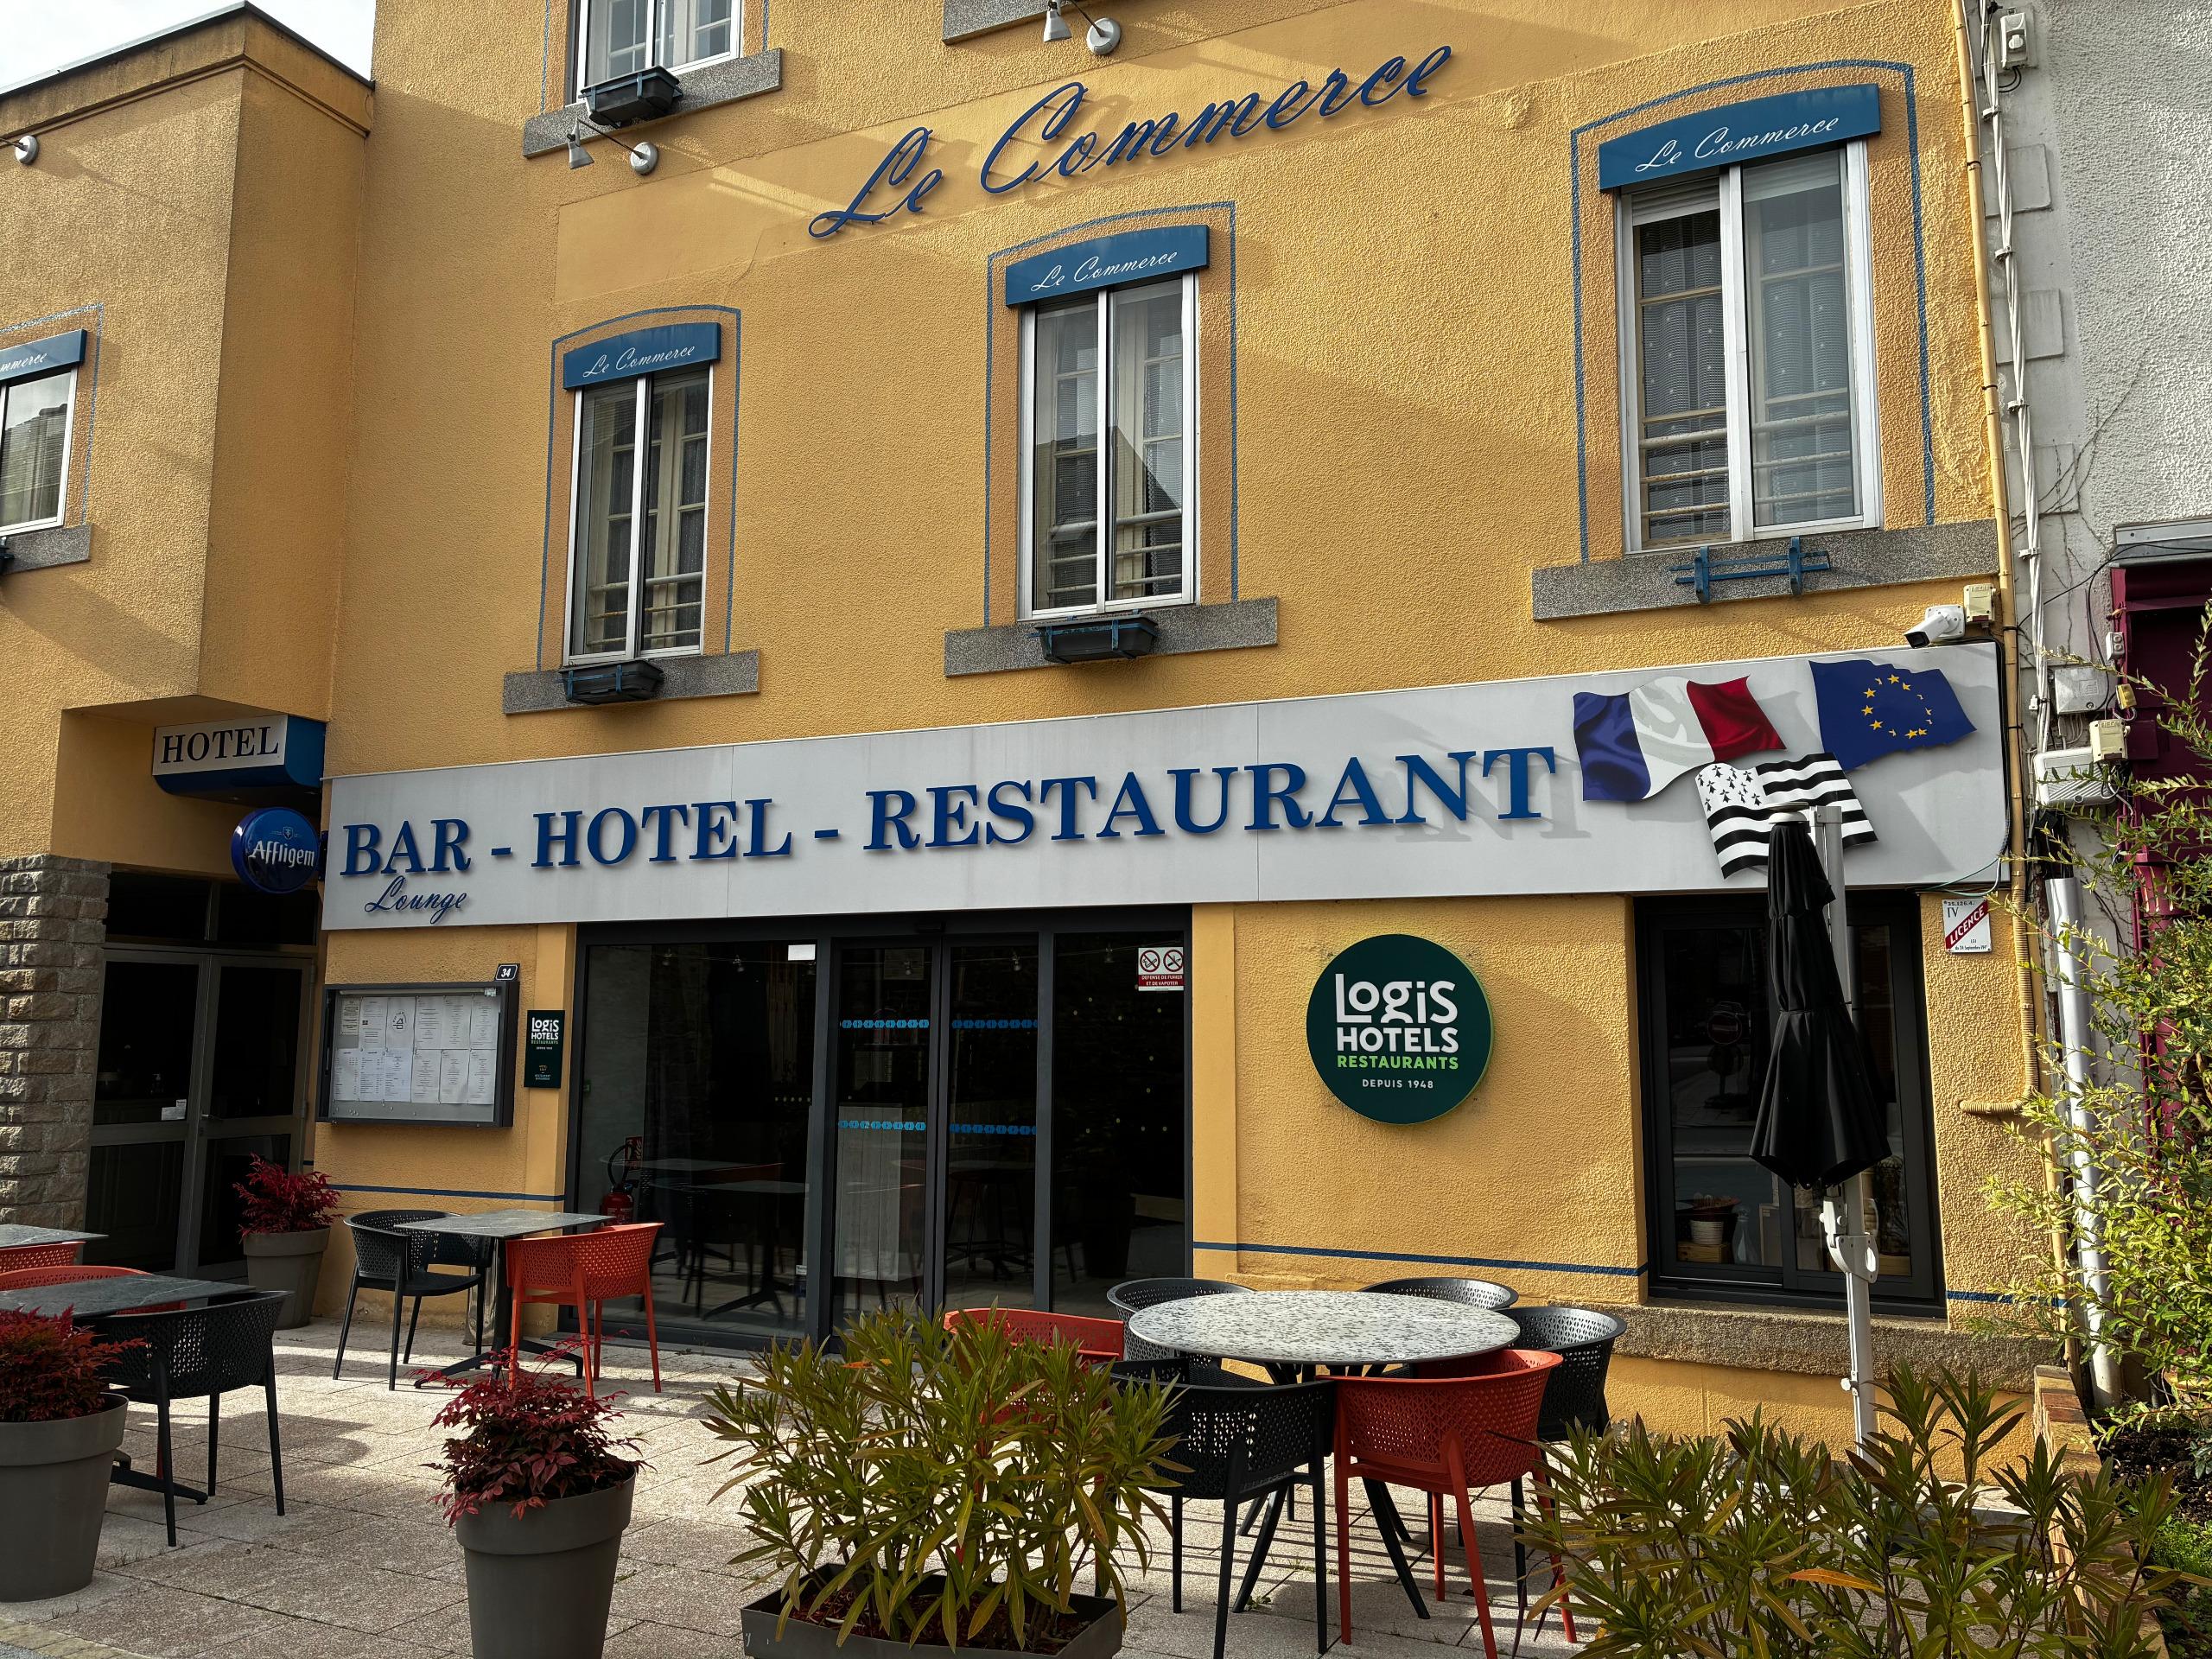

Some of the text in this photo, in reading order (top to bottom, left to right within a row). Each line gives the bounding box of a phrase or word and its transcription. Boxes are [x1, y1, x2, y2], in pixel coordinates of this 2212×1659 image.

[808, 45, 1452, 238] Le Commerce
[1635, 117, 1840, 173] Le Commerce
[1030, 251, 1178, 292] Le Commerce
[582, 346, 696, 378] Le Commerce
[160, 726, 279, 764] HOTEL
[340, 818, 472, 876] BAR
[531, 798, 792, 868] HOTEL
[863, 746, 1556, 850] RESTAURANT
[247, 840, 315, 868] Affligem
[364, 874, 468, 925] Lounge
[1950, 905, 1985, 945] LICENCE
[500, 968, 512, 977] 34
[531, 1032, 559, 1040] HOTELS
[1336, 1027, 1460, 1053] HOTELS
[1337, 1054, 1459, 1071] RESTAURANTS
[1362, 1078, 1434, 1089] DEPUIS 1948
